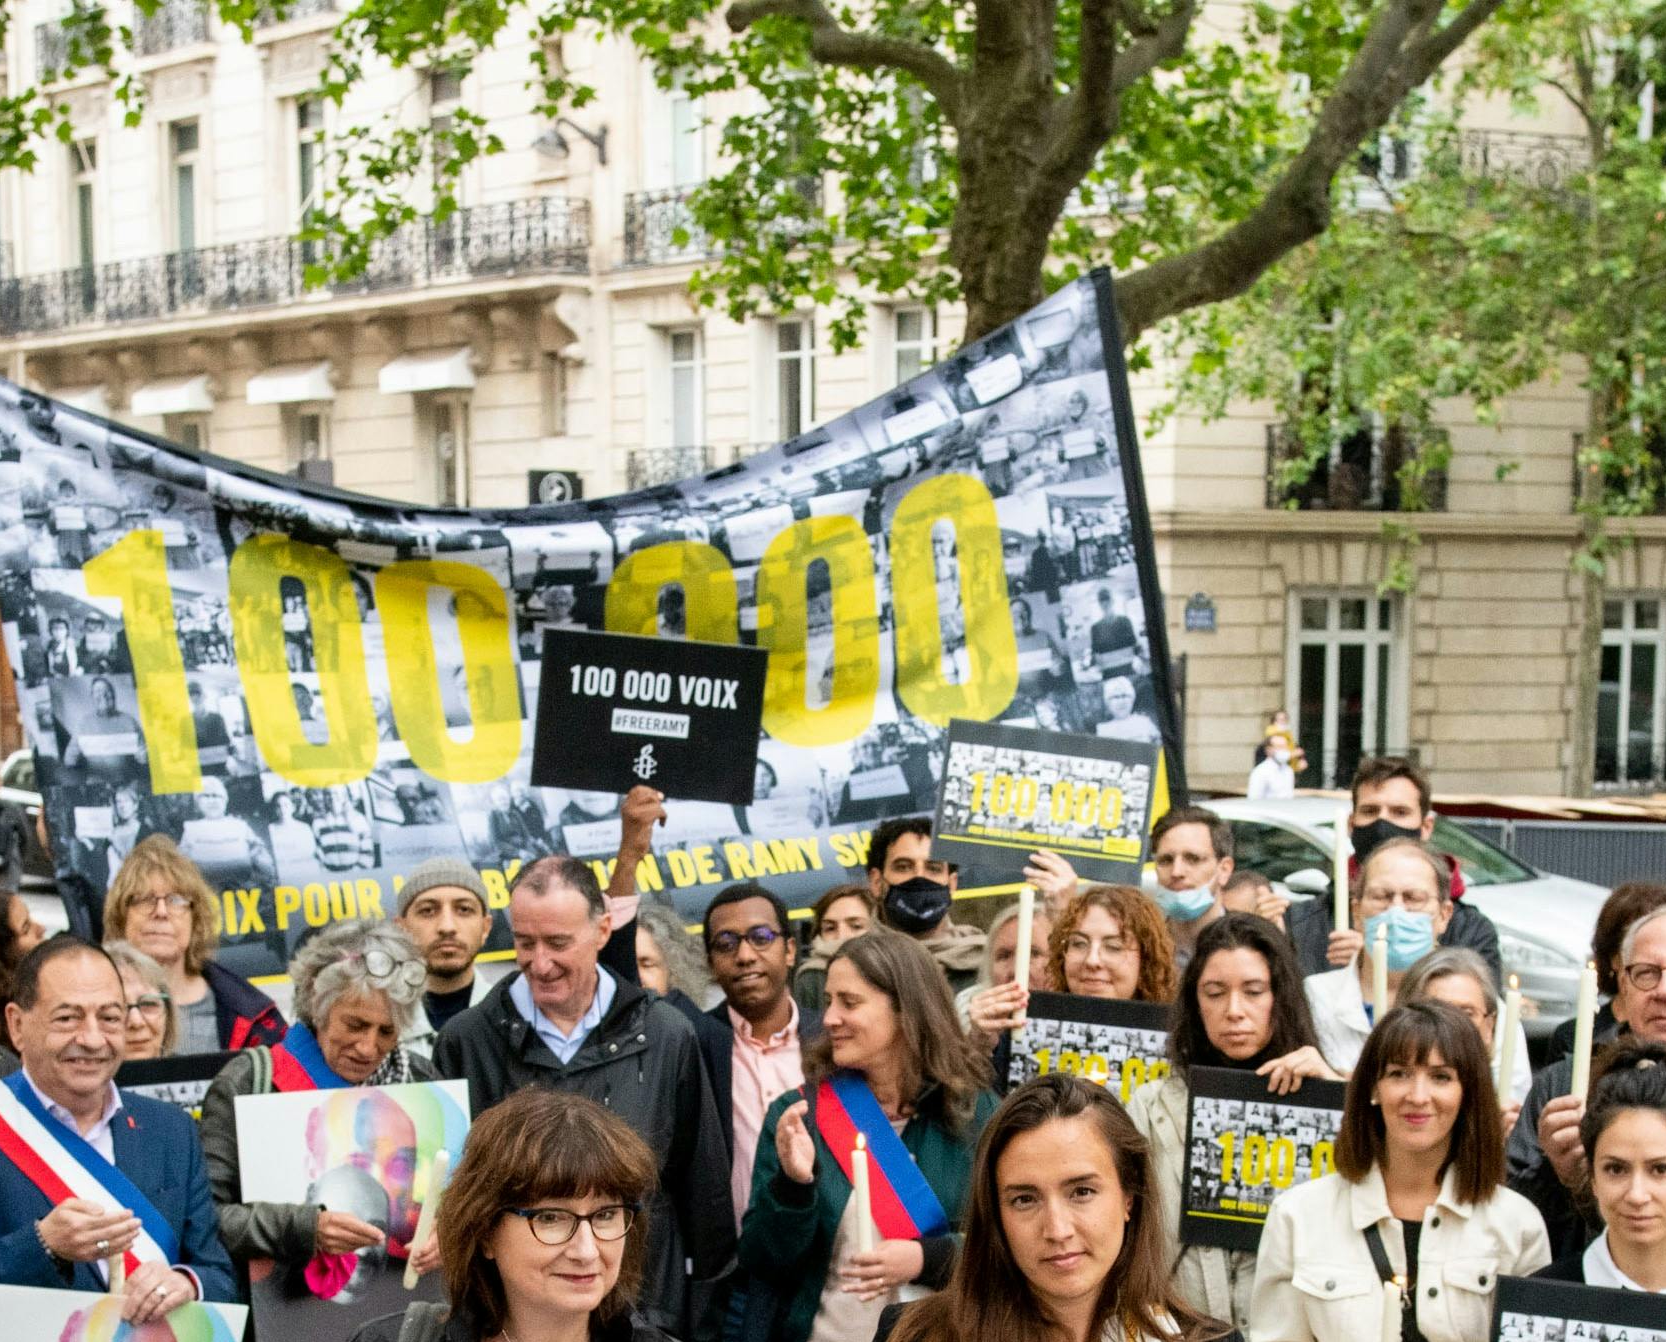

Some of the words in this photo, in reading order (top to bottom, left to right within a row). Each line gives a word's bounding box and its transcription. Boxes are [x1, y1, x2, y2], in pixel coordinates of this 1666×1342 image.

[83, 529, 523, 794] 100
[570, 663, 617, 698] 100
[622, 669, 672, 703] 000
[678, 674, 740, 710] VOIX
[614, 714, 687, 734] #FREERAMY
[970, 770, 1038, 818] 100
[1048, 779, 1123, 830] 000
[667, 845, 723, 889] DE
[723, 836, 824, 881] RAMY
[273, 878, 385, 931] POUR
[1217, 1129, 1296, 1189] 100
